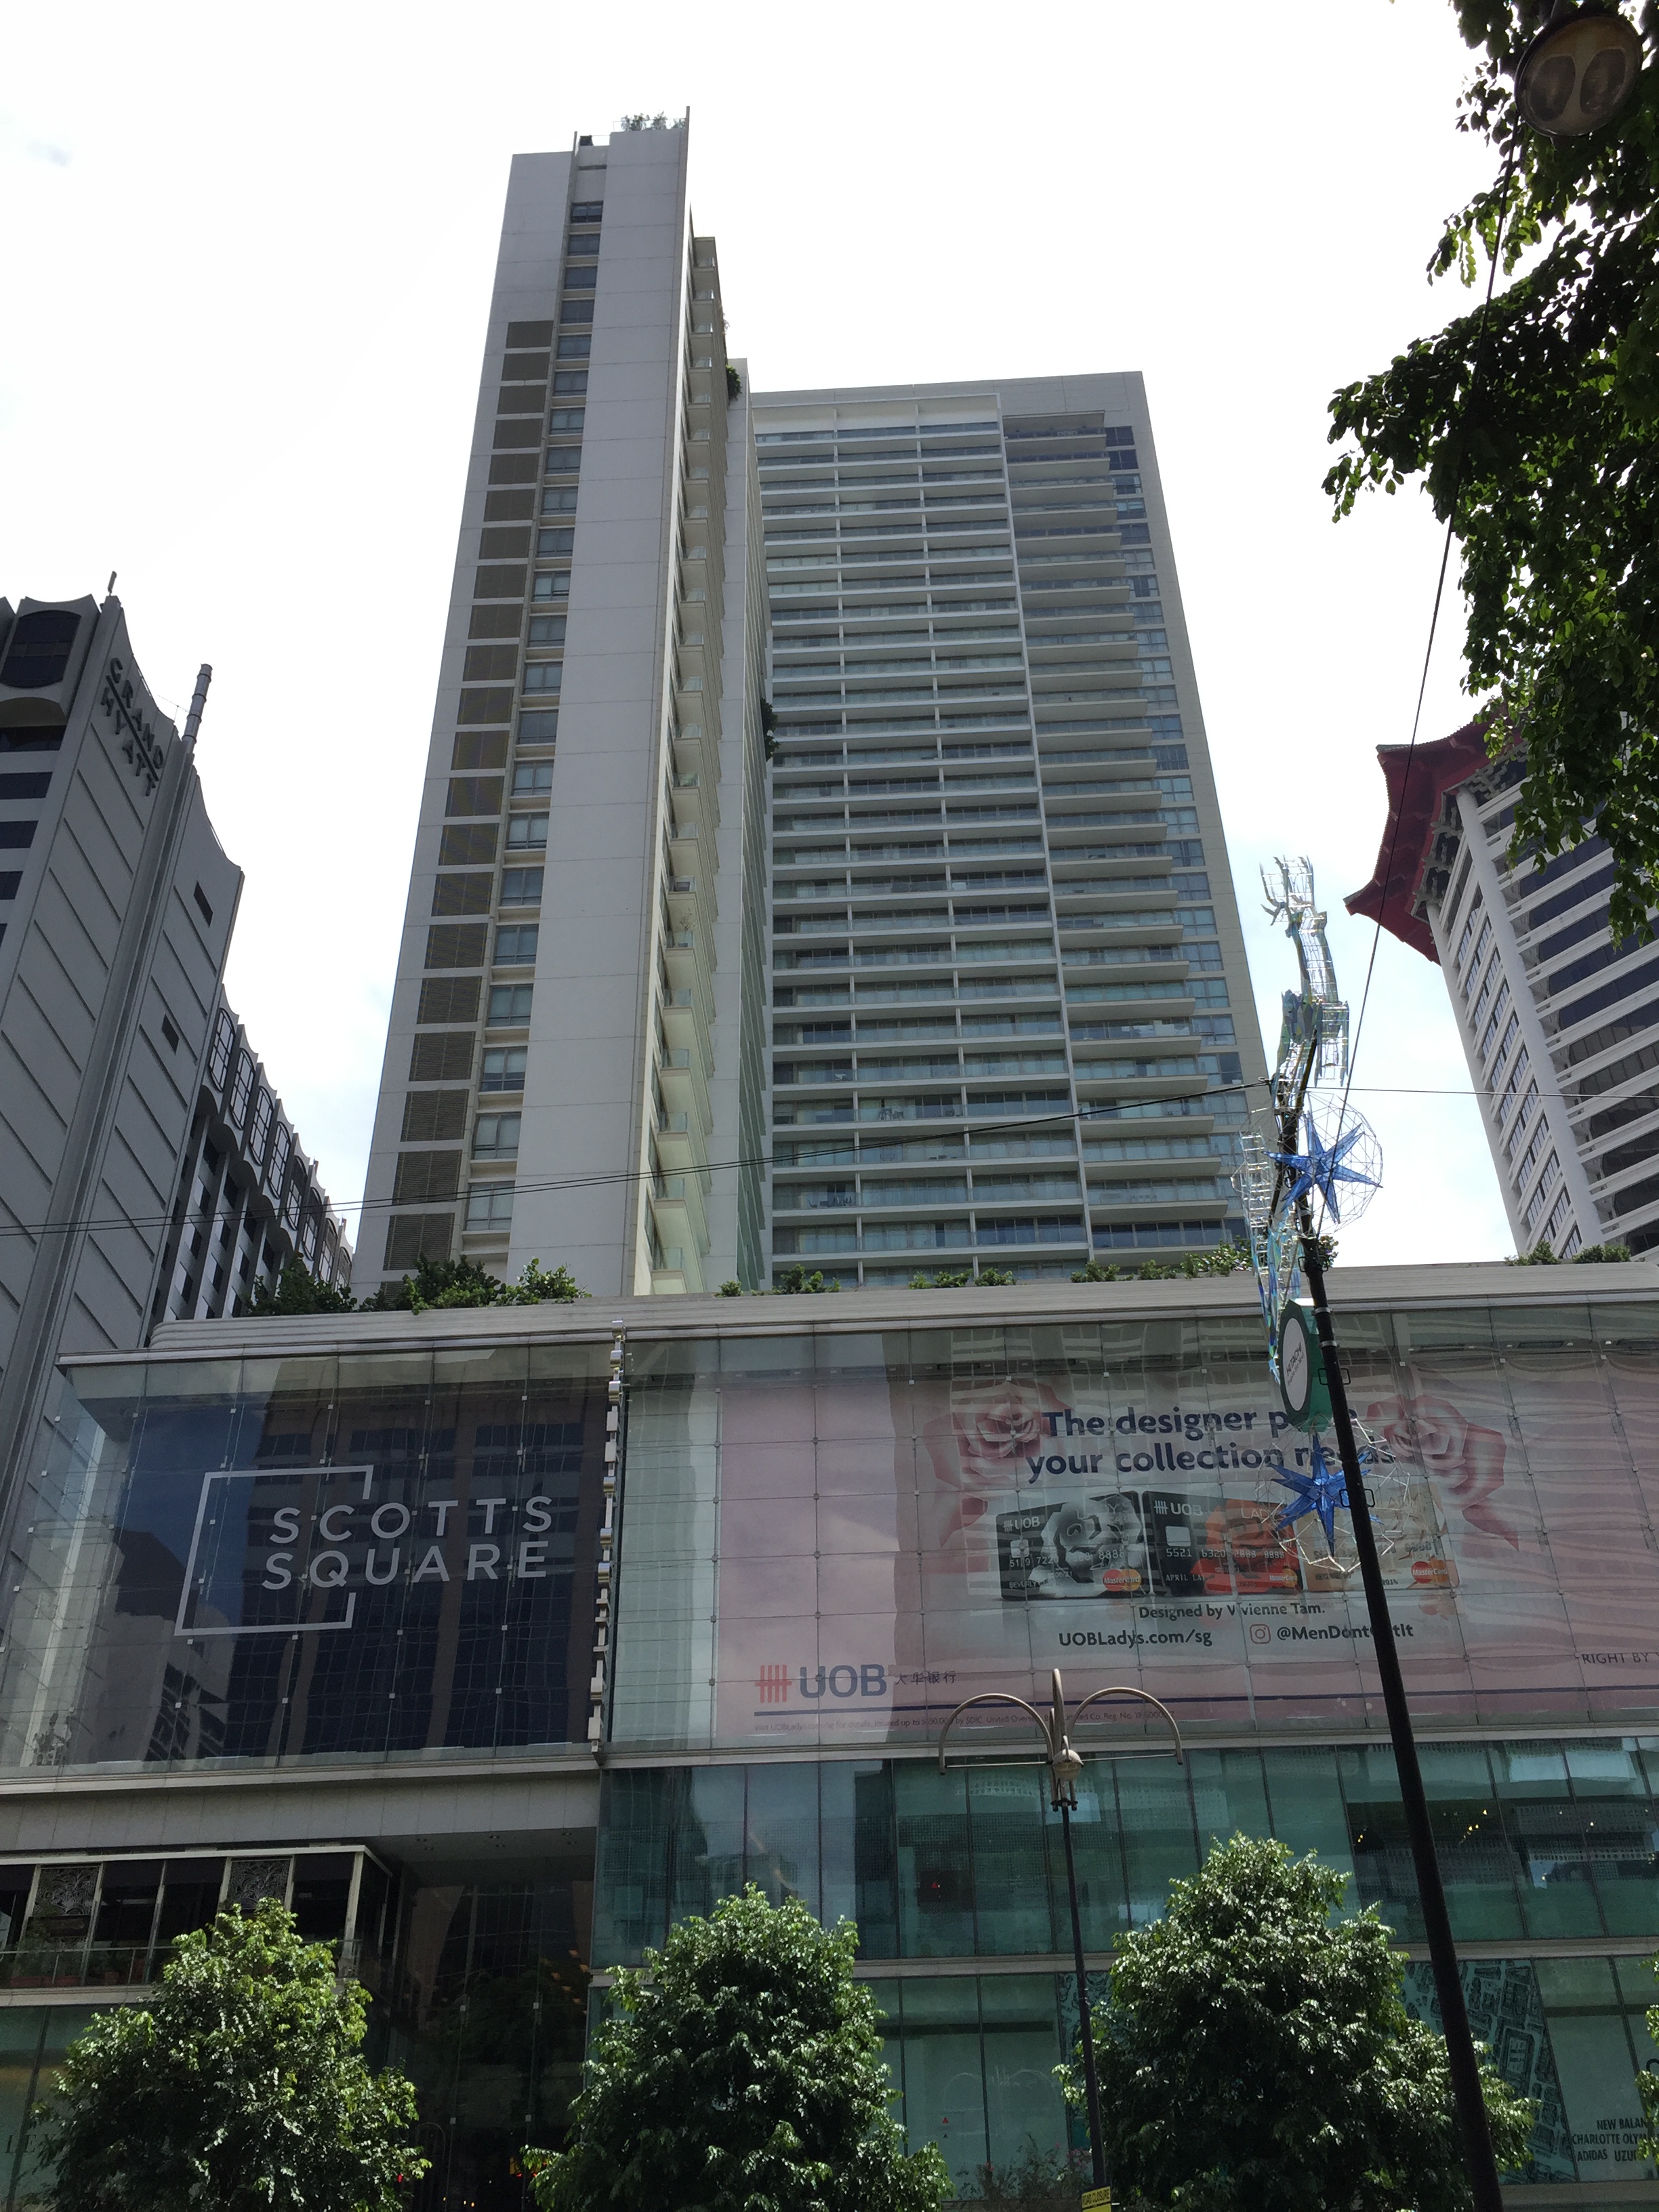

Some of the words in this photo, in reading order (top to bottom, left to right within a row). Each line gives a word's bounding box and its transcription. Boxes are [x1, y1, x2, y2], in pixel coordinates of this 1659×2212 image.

[110, 657, 164, 769] GRAND
[101, 687, 157, 796] HYATT
[1042, 1409, 1105, 1436] The
[1116, 1406, 1257, 1441] designer
[1026, 1454, 1103, 1484] your
[1115, 1441, 1279, 1473] collection
[1170, 1502, 1204, 1516] UOB
[269, 1496, 552, 1544] SCOTTS
[1015, 1516, 1040, 1530] UOB
[262, 1540, 549, 1590] SQUARE
[1139, 1603, 1202, 1621] Designed
[1207, 1603, 1223, 1620] by
[1227, 1603, 1288, 1616] Vvienne
[1290, 1602, 1326, 1615] Tam.
[1059, 1629, 1213, 1649] UOBLadys.com/sg
[1582, 1652, 1625, 1664] RIGHT
[1632, 1652, 1649, 1663] BY
[800, 1664, 888, 1699] UOB
[894, 1670, 957, 1687] 大华银行
[1597, 2118, 1617, 2131] NEW
[1572, 2133, 1620, 2146] CHARLOTTE
[1577, 2149, 1608, 2162] ADIDAS
